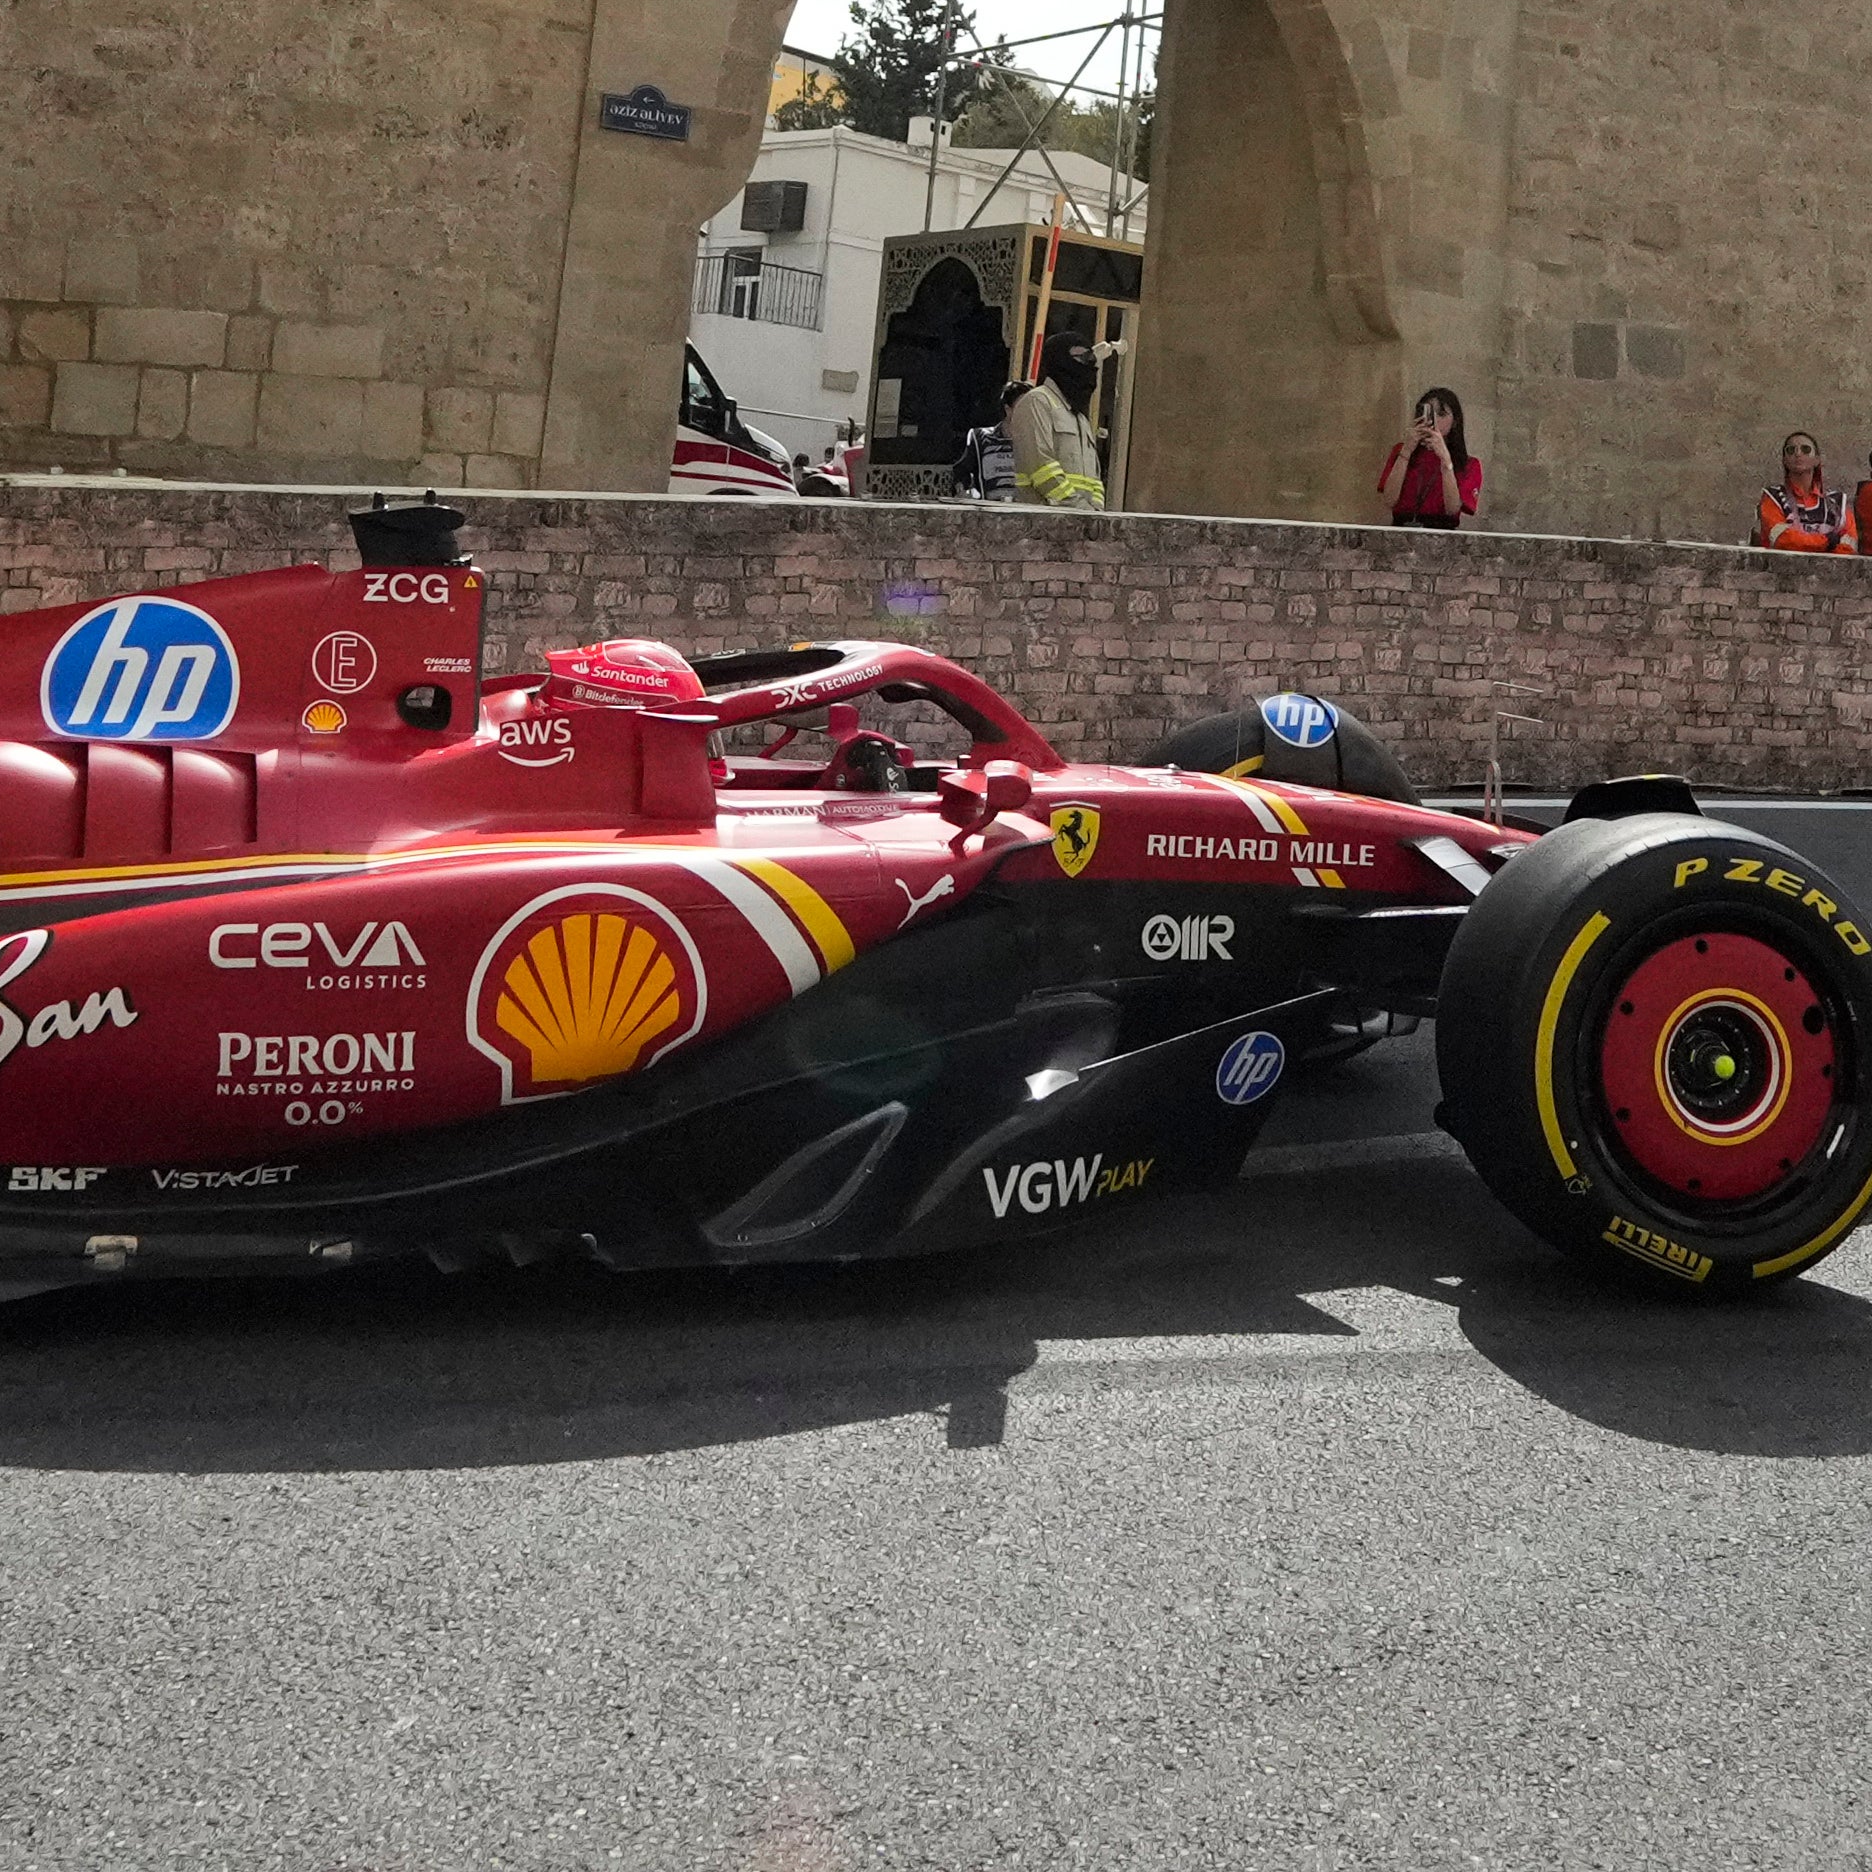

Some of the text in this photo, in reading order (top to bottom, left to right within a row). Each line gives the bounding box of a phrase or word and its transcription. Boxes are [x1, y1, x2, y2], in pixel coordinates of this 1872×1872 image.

[66, 598, 218, 740] hp
[423, 658, 470, 666] CHARLES
[426, 665, 472, 673] LECLERC
[591, 665, 669, 688] Santander
[818, 663, 883, 693] TECHNOLOGY
[499, 717, 572, 748] aws
[1278, 694, 1326, 745] hp
[1146, 834, 1376, 867] RICHARD MILLE
[1674, 857, 1872, 956] P ZERO
[306, 974, 427, 990] LOGISTICS
[216, 1031, 416, 1078] PERONI
[1225, 1034, 1278, 1103] hp
[216, 1078, 415, 1096] NASTRO AZZURRO
[284, 1100, 364, 1126] 0.0%
[8, 1167, 108, 1191] SKF
[981, 1154, 1155, 1218] VGW PLAY
[1602, 1215, 1714, 1283] PIRELLI
